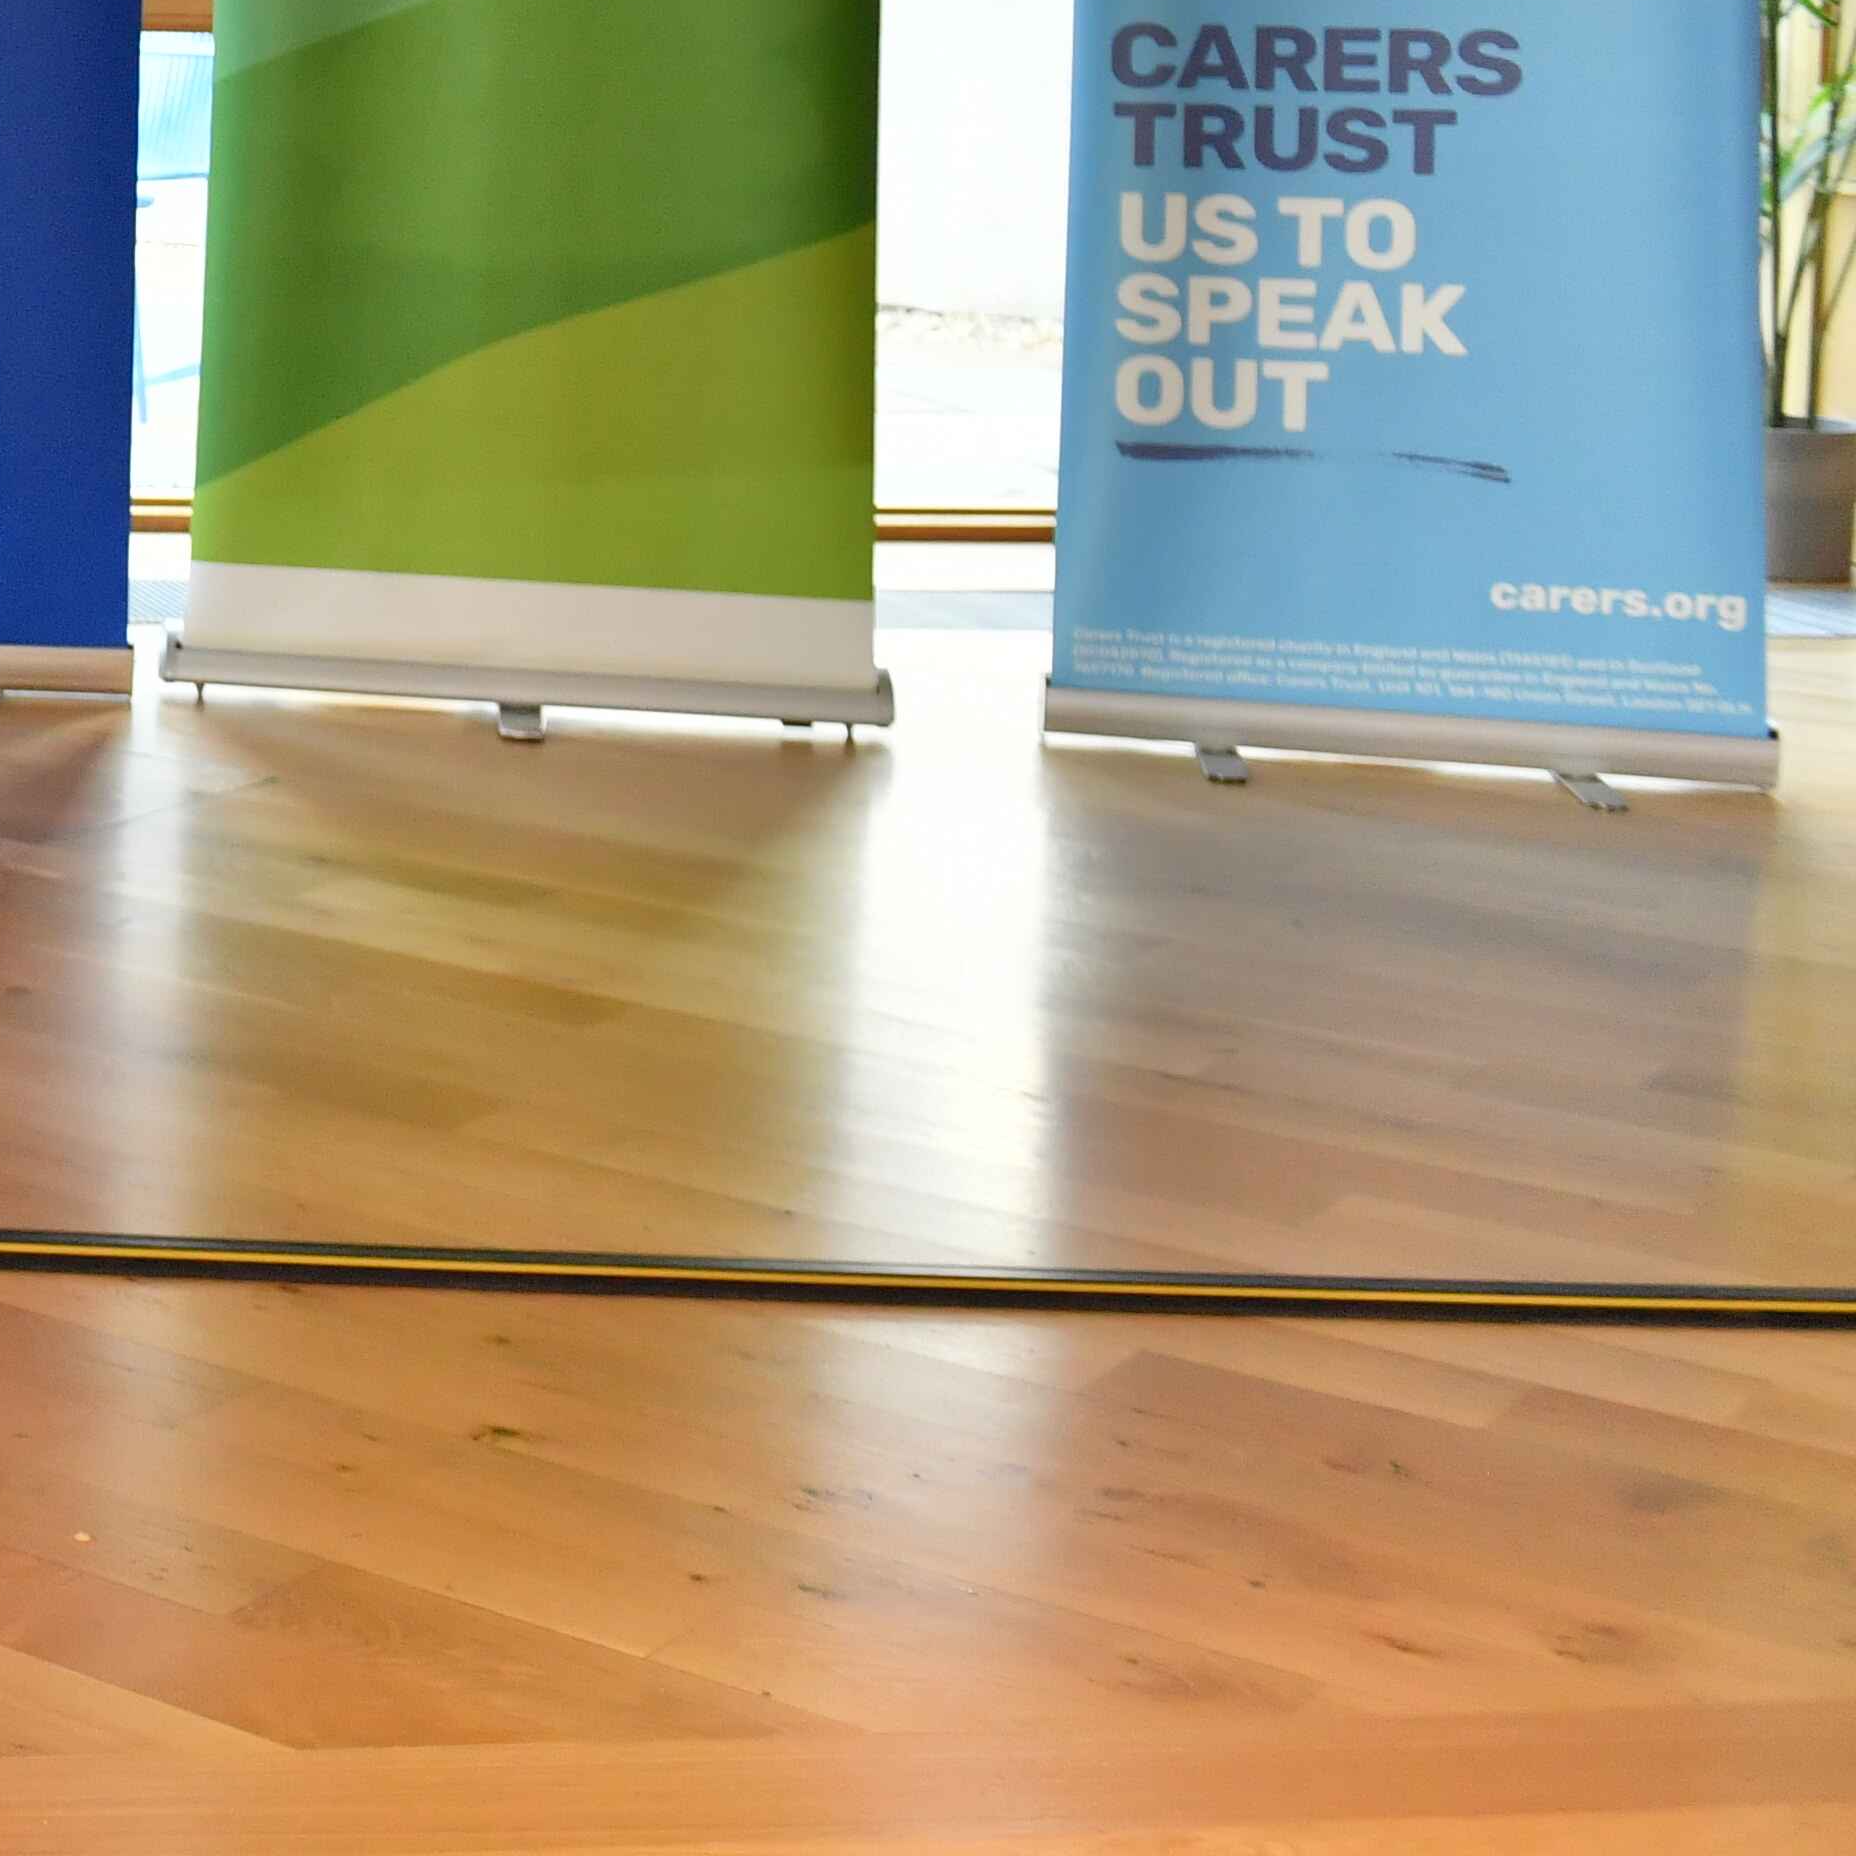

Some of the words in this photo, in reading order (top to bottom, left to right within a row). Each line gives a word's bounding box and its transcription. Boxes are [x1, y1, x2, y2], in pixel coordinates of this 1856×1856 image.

[1111, 23, 1523, 95] CARERS
[1114, 102, 1455, 173] TRUST
[1121, 193, 1257, 263] US
[1279, 199, 1415, 270] TO
[1114, 273, 1467, 356] SPEAK
[1117, 354, 1329, 431] OUT
[1490, 583, 1746, 630] carers.org
